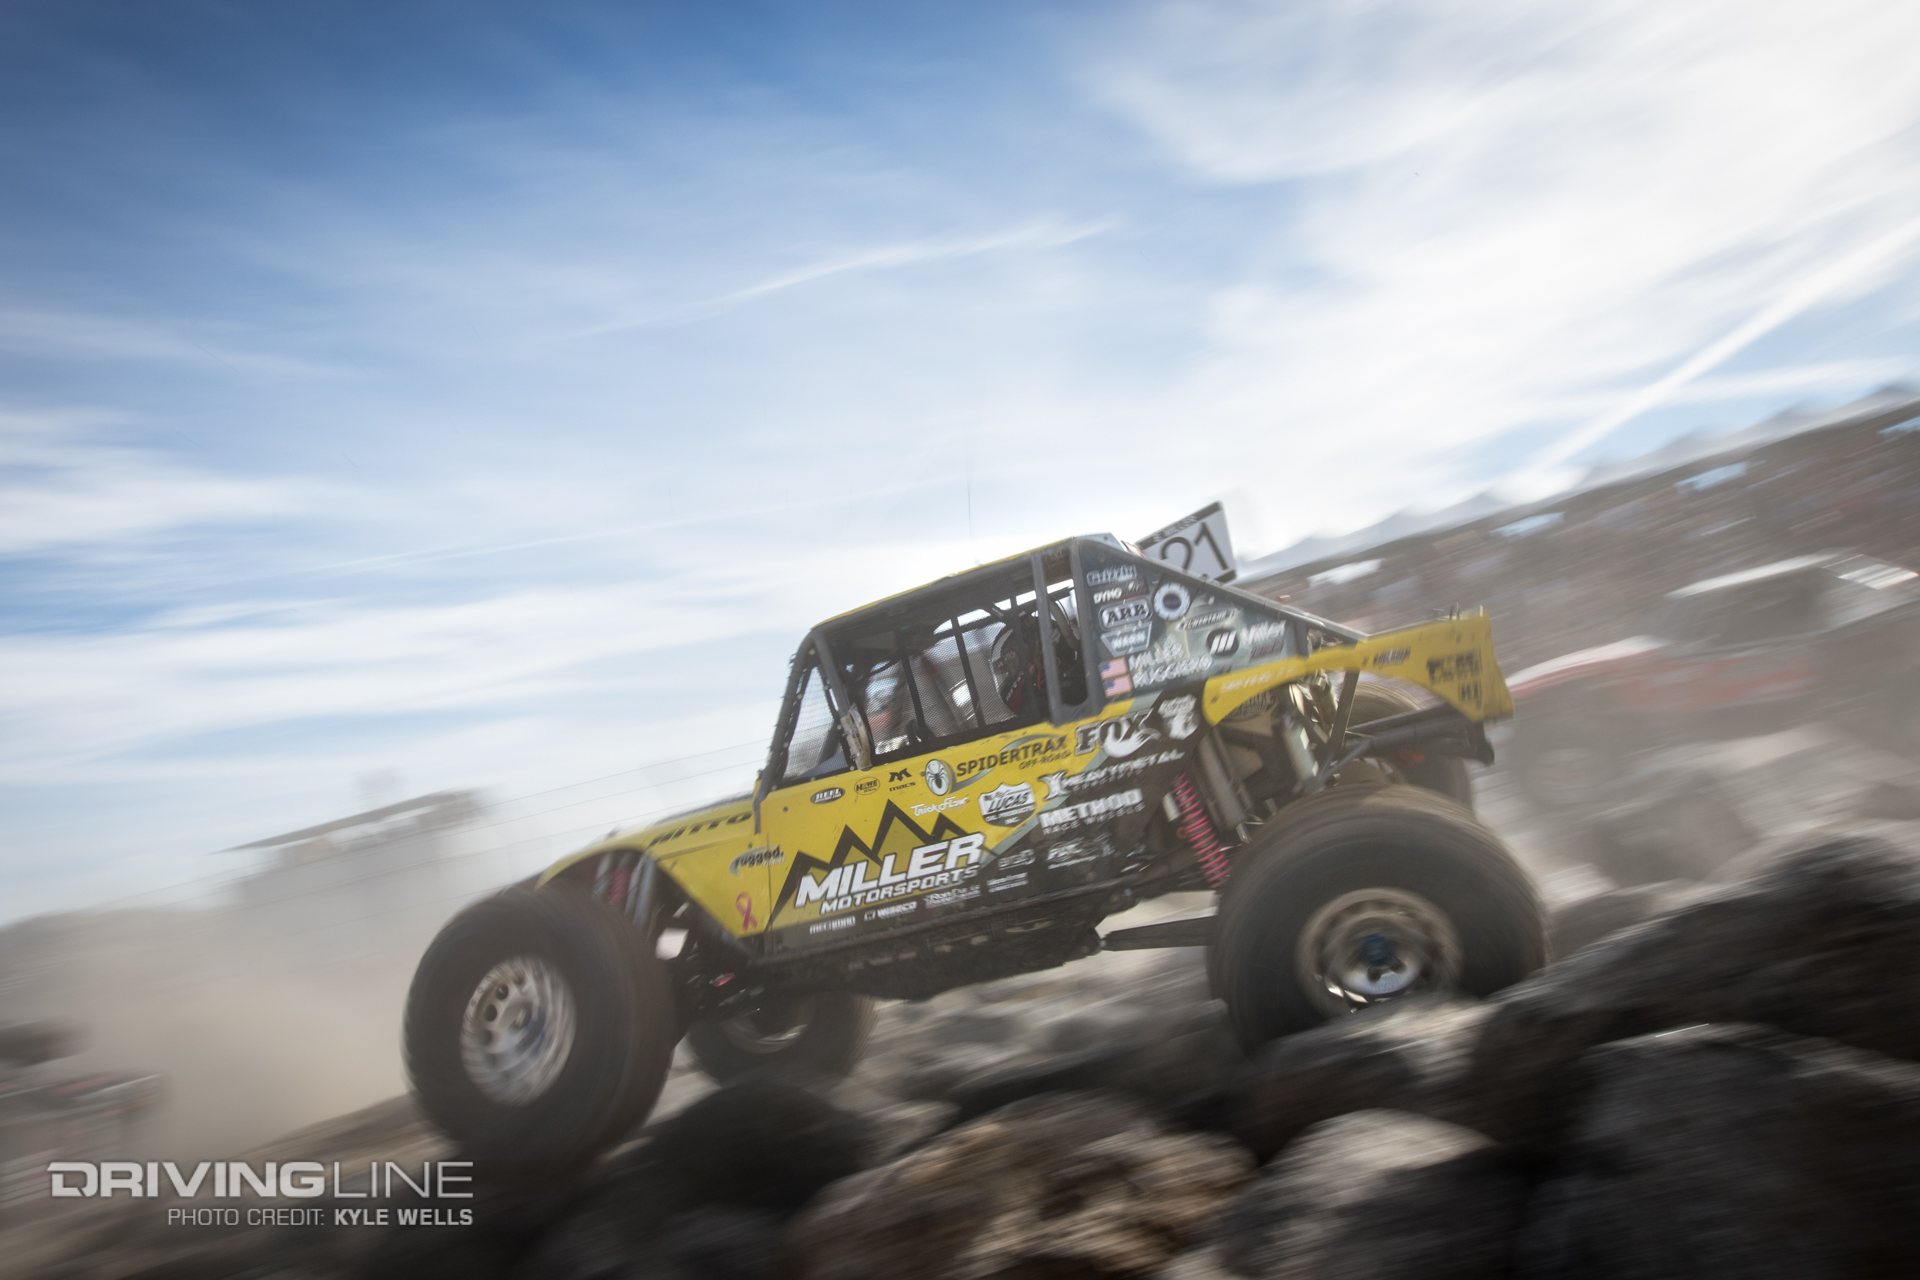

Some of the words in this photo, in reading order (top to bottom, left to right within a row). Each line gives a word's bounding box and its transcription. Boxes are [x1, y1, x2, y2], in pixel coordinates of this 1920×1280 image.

[957, 734, 1068, 777] SPIDERTRAX
[1076, 708, 1154, 756] FOX
[988, 792, 1029, 812] LUCAS
[795, 832, 985, 909] MILLER
[820, 865, 981, 915] MOTORSPORTS
